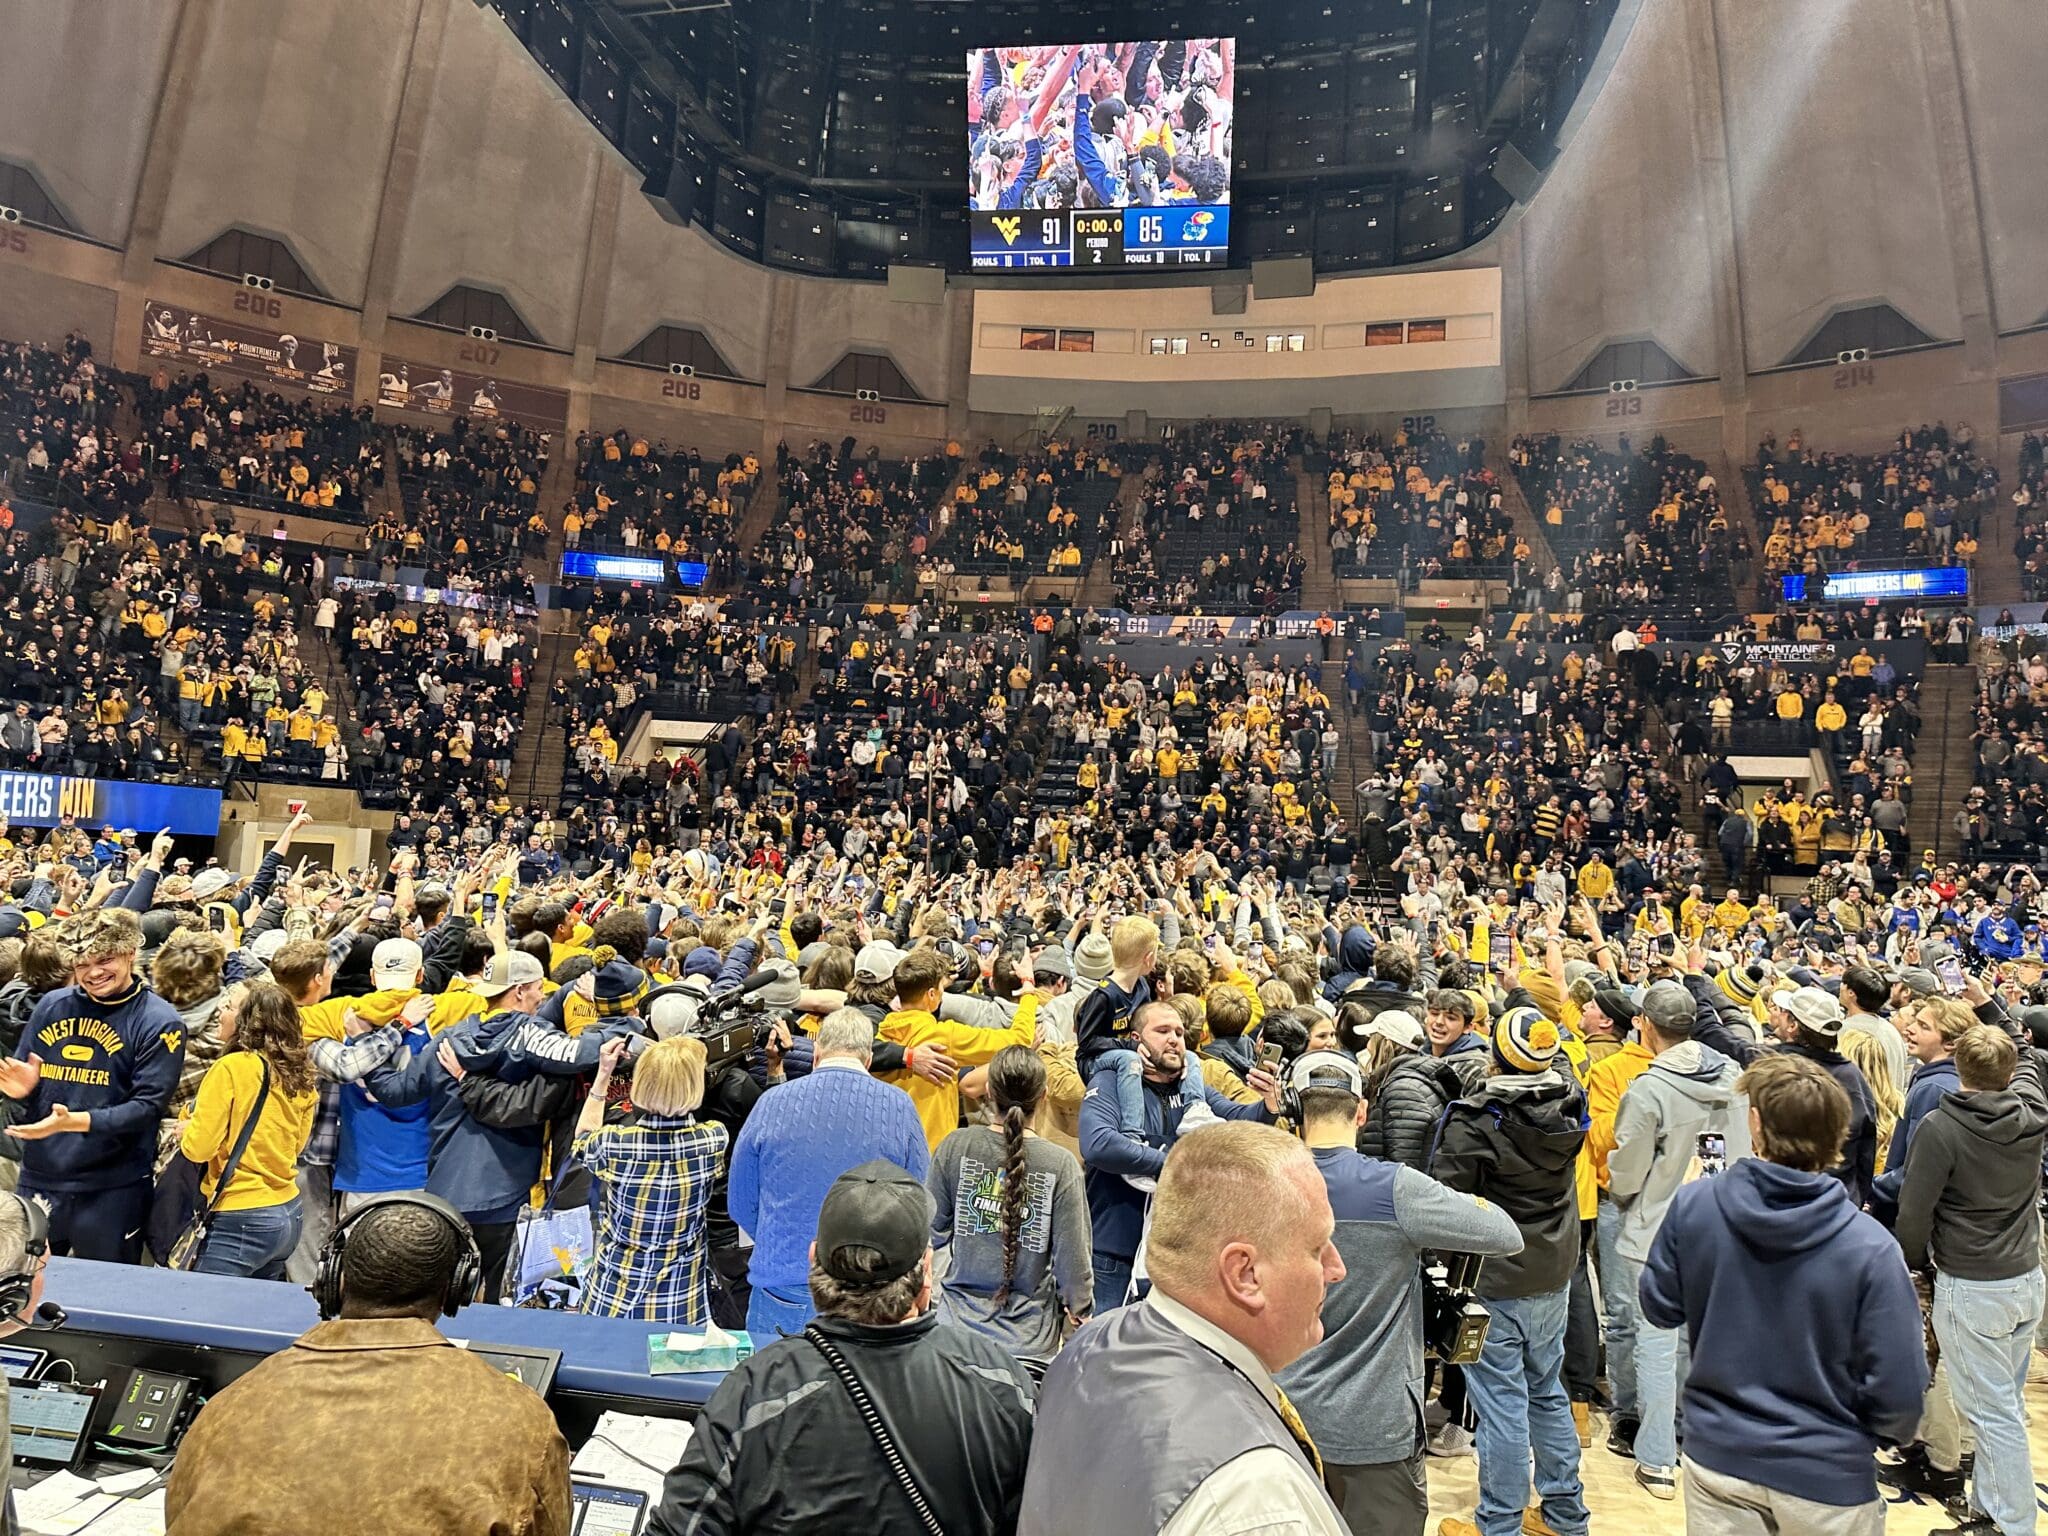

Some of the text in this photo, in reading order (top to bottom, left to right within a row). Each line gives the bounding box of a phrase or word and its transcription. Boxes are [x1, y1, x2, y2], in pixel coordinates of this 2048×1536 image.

[1042, 218, 1061, 245] 91
[1076, 218, 1123, 233] 0:00.0
[1139, 215, 1163, 243] 85
[972, 257, 998, 267] FOULS
[1029, 256, 1045, 266] TOL
[1092, 250, 1102, 263] 2
[1125, 254, 1151, 263] FOULS
[1184, 253, 1200, 262] TOL
[234, 289, 281, 319] 206
[239, 342, 281, 359] MOUNTAINEER
[459, 342, 501, 366] 207
[1832, 365, 1875, 390] 214
[662, 378, 701, 401] 208
[850, 404, 886, 425] 209
[1606, 396, 1641, 418] 213
[1127, 617, 1149, 633] GO
[1745, 644, 1835, 655] MOUNTAINER
[58, 776, 96, 819] WIN
[1112, 1018, 1128, 1031] WEST
[37, 1017, 124, 1058] WEST VIRGINIA
[39, 1063, 110, 1086] MOUNTAINEERS
[1168, 1095, 1185, 1109] WV
[973, 1196, 1002, 1213] FINAL
